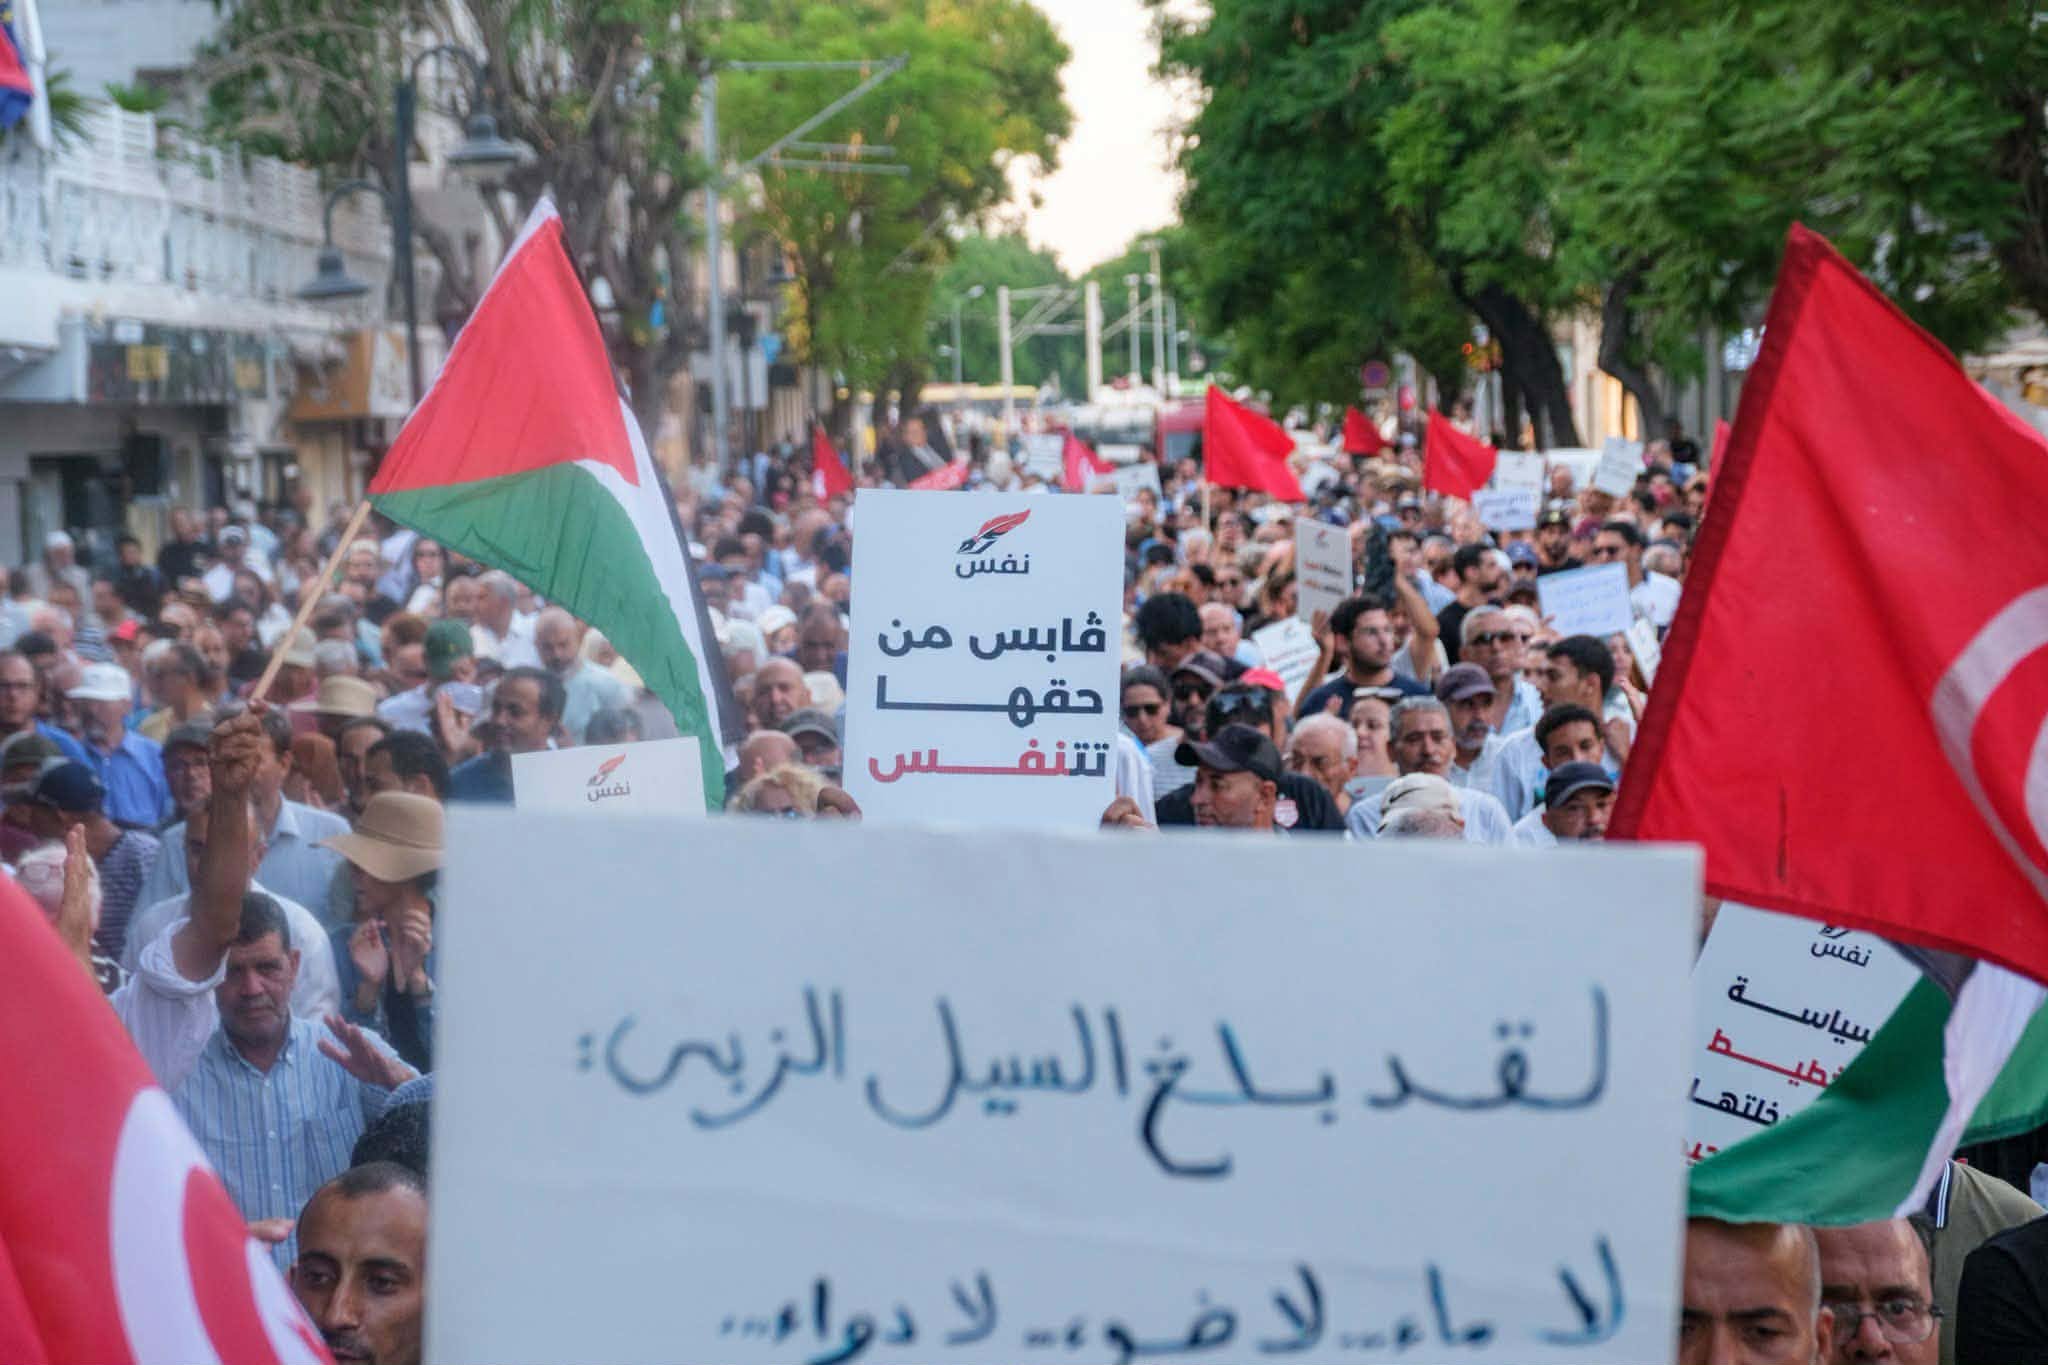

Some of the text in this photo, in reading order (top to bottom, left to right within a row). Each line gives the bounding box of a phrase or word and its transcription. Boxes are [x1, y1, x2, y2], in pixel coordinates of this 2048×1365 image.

[955, 553, 1030, 579] نفس
[877, 619, 953, 658] من
[876, 675, 1104, 728] حقها
[586, 781, 631, 803] نفس
[868, 738, 1110, 783] تتنفس
[1811, 942, 1872, 967] نفس
[864, 998, 1130, 1130] السيل
[1363, 984, 1610, 1112] لقد
[1136, 1022, 1338, 1180] بلغ
[944, 1270, 998, 1346] لا
[1256, 1264, 1324, 1353] لا
[1538, 1234, 1626, 1345] لا
